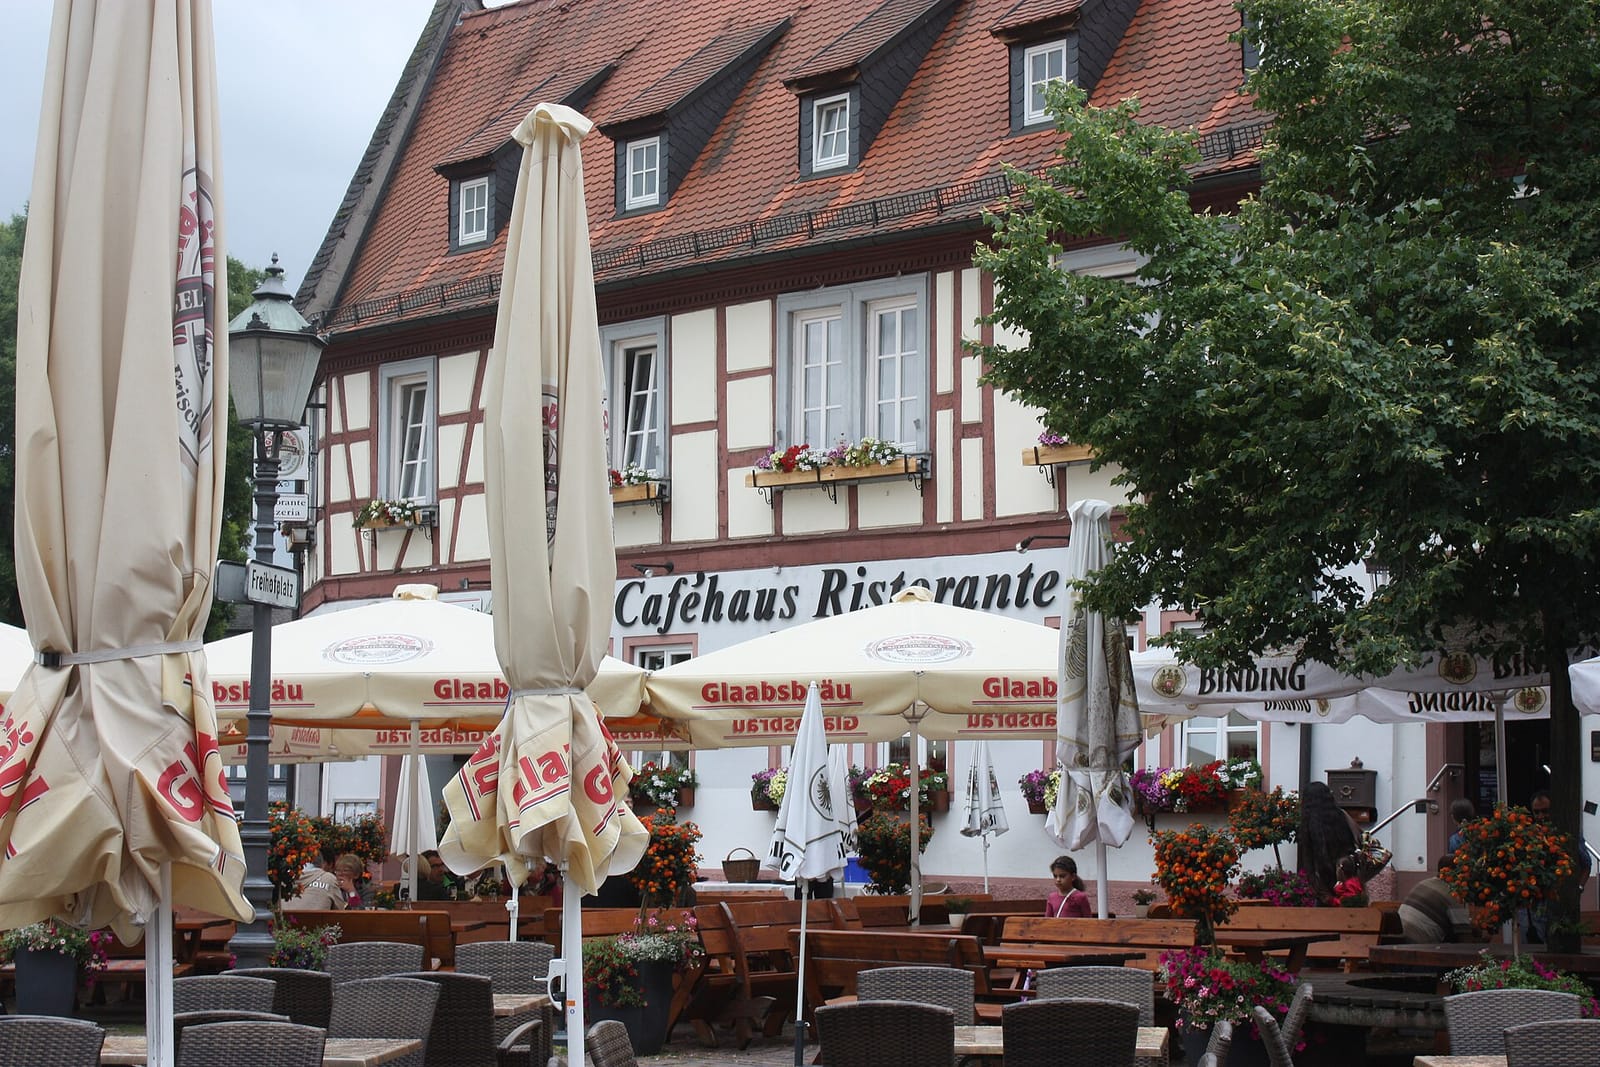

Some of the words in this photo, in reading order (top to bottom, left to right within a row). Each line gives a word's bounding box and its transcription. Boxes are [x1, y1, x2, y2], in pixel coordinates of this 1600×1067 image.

[276, 507, 300, 516] zeria
[251, 569, 294, 599] Freihofplatz
[614, 571, 800, 635] Caféhaus
[434, 678, 510, 700] Glaab
[982, 676, 1058, 698] Glaab
[1198, 661, 1306, 695] BINDING
[212, 679, 304, 702] bsbäu
[701, 679, 853, 703] Glaabsbäu
